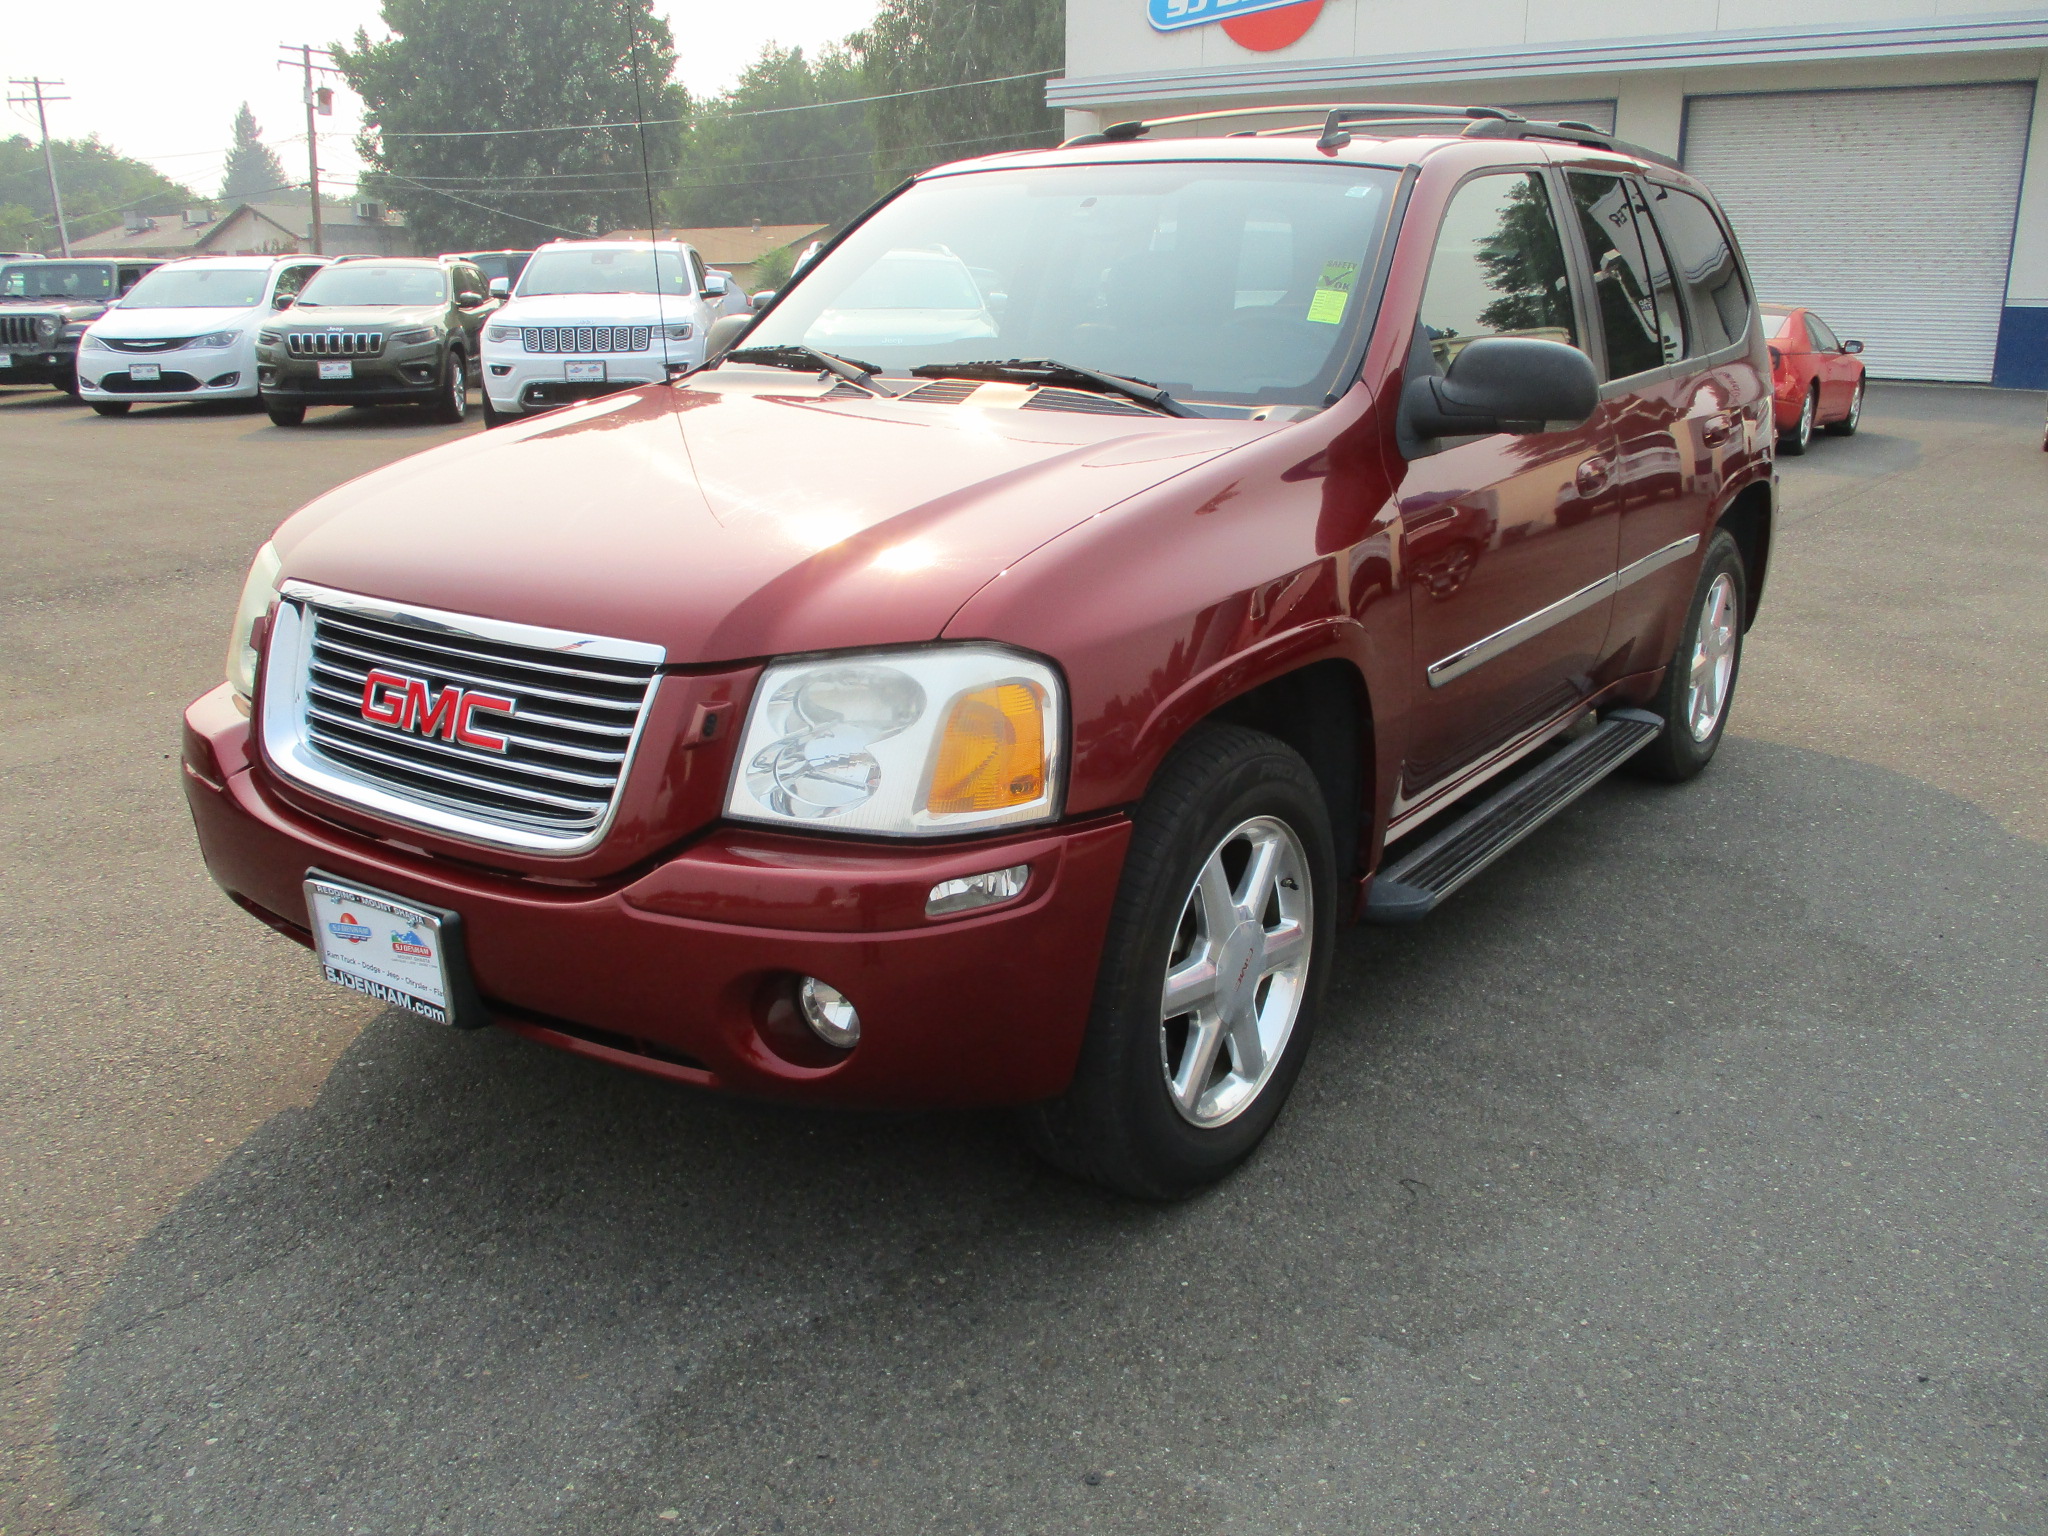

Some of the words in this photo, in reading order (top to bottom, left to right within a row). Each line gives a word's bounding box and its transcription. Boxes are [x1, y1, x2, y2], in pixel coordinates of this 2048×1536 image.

[1334, 282, 1350, 290] OK
[361, 668, 518, 755] GMC
[316, 885, 355, 902] REDDING
[360, 897, 392, 913] MOUNT
[393, 908, 425, 925] SHASTA
[395, 943, 403, 951] SJ
[403, 944, 429, 955] DENHAM
[326, 950, 340, 961] Ram
[340, 954, 356, 965] Truck
[361, 961, 381, 974] Dodge
[386, 970, 400, 981] Jeep
[405, 977, 428, 991] Chrysler
[325, 966, 446, 1024] SJDENHAM.com
